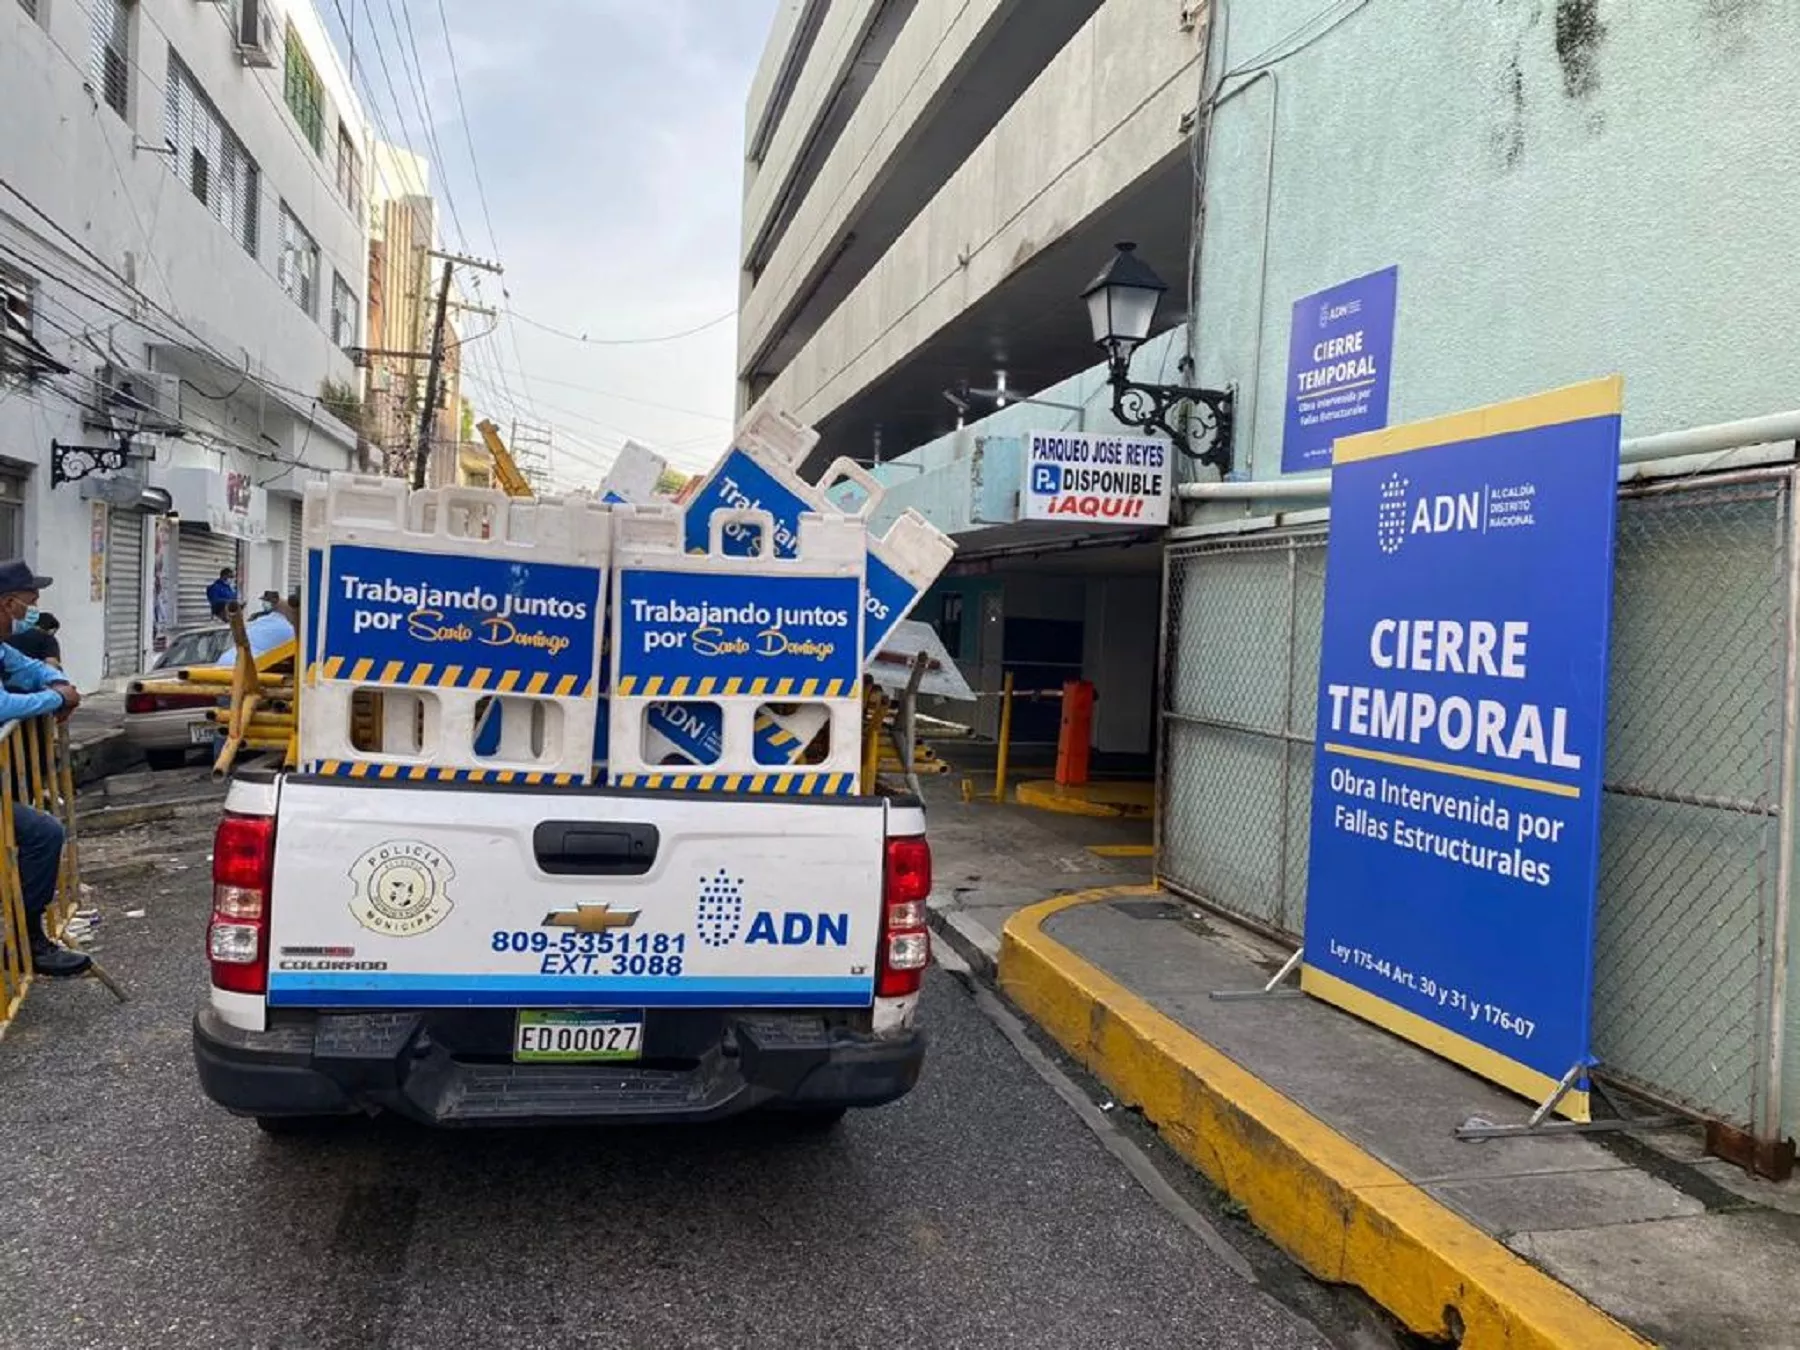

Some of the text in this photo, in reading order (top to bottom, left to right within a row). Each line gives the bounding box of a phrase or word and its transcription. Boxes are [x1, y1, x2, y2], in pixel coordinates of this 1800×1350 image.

[1313, 330, 1363, 363] CIERRE
[1297, 354, 1376, 392] TEMPORAL
[1033, 437, 1164, 468] PARQUEO JOSÉ REYES
[1063, 468, 1162, 496] DISPONIBLE
[1410, 482, 1536, 534] ADN ALCALDÍA
[1489, 514, 1535, 528] NACIONAL
[1490, 499, 1531, 514] DISTRITO
[340, 575, 587, 620] Trabajando Juntos
[631, 599, 848, 630] Trabajando Juntos
[354, 608, 570, 655] por Santo Domingo
[644, 626, 834, 661] por Santo Domingo
[1370, 618, 1529, 679] CIERRE
[1328, 684, 1581, 769] TEMPORAL
[1330, 767, 1565, 843] Obra Intervenida por
[367, 845, 441, 868] POLICIA
[1335, 805, 1551, 886] Fallas Estructurales
[366, 907, 440, 932] MUNICIPAL
[745, 911, 849, 947] ADN
[491, 931, 686, 954] 809-5351181
[279, 960, 388, 971] COLORADO
[540, 953, 683, 976] EXT. 3088
[1331, 939, 1536, 1040] Ley 175-44 Art. 30 y 31 y 176-07
[521, 1027, 637, 1051] ED00027
